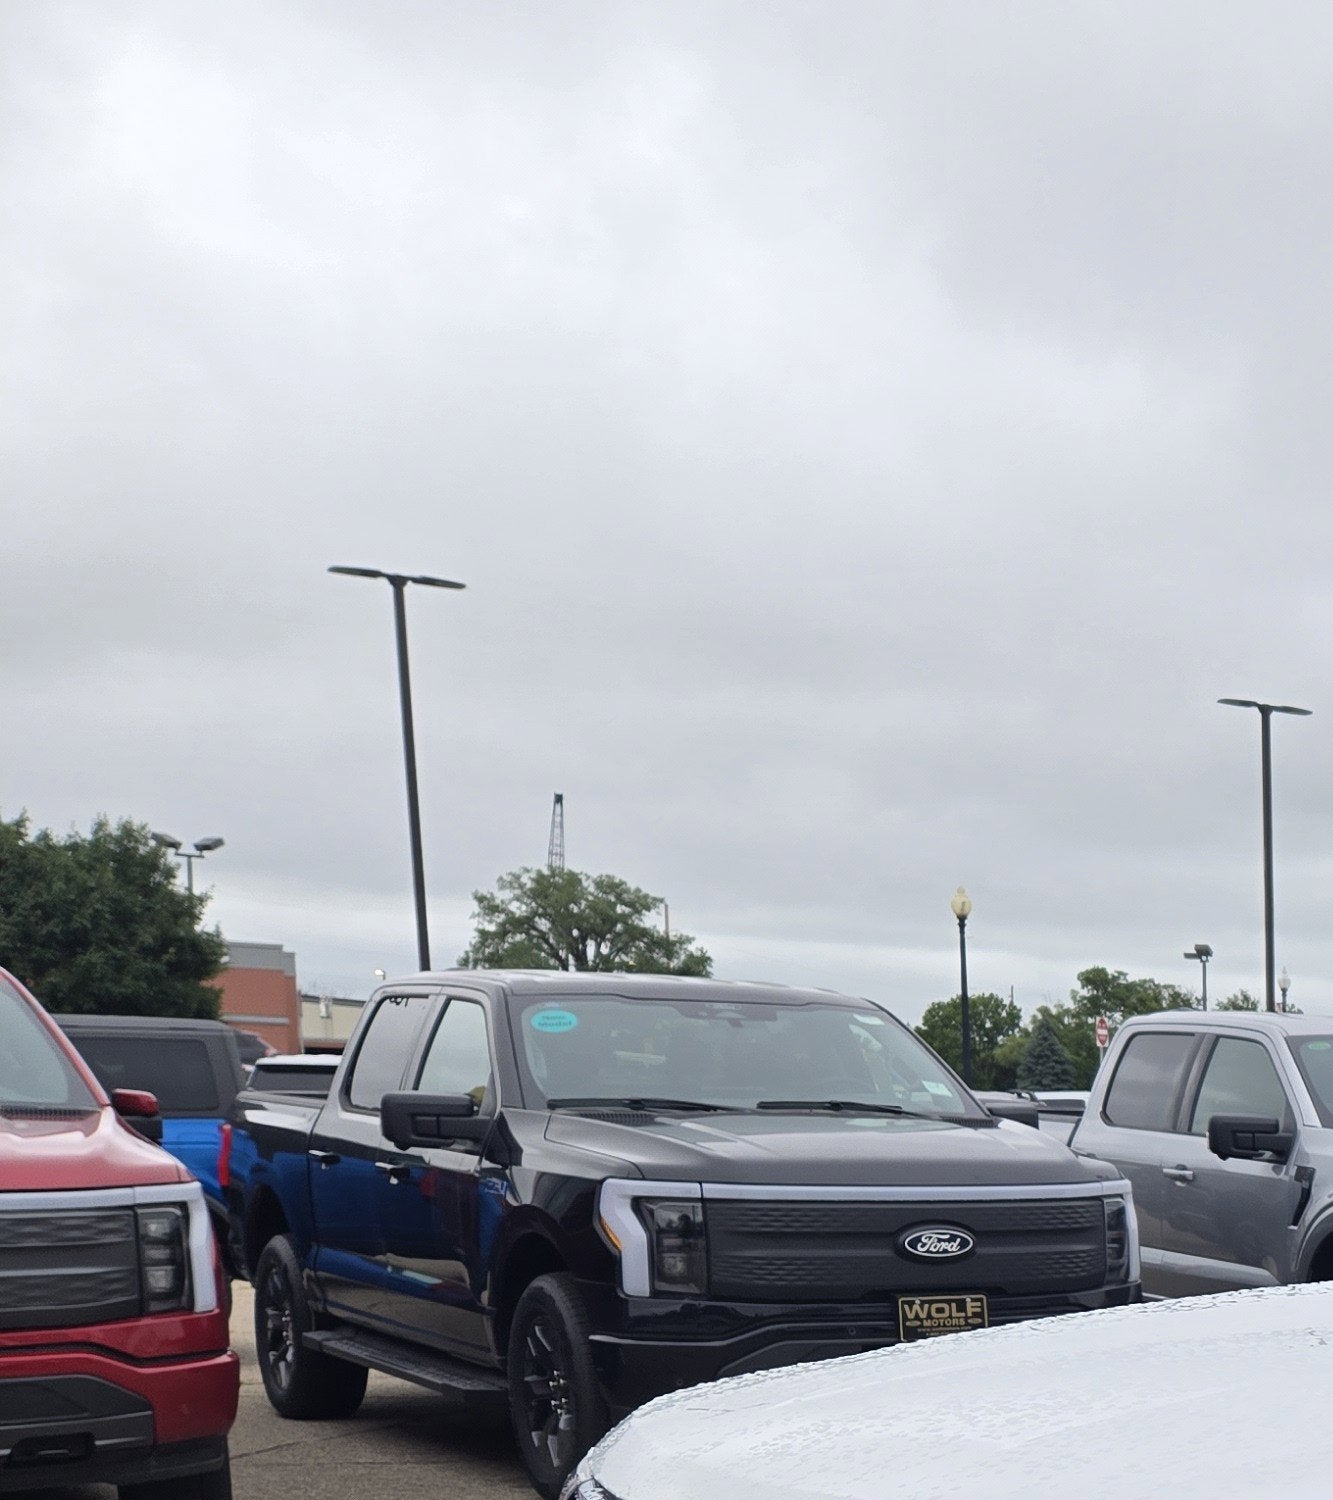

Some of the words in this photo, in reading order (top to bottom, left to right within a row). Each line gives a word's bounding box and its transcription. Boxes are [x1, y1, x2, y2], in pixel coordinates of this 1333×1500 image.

[917, 1233, 962, 1252] Ford
[904, 1301, 981, 1319] WOLF
[923, 1318, 965, 1327] MOTORS
